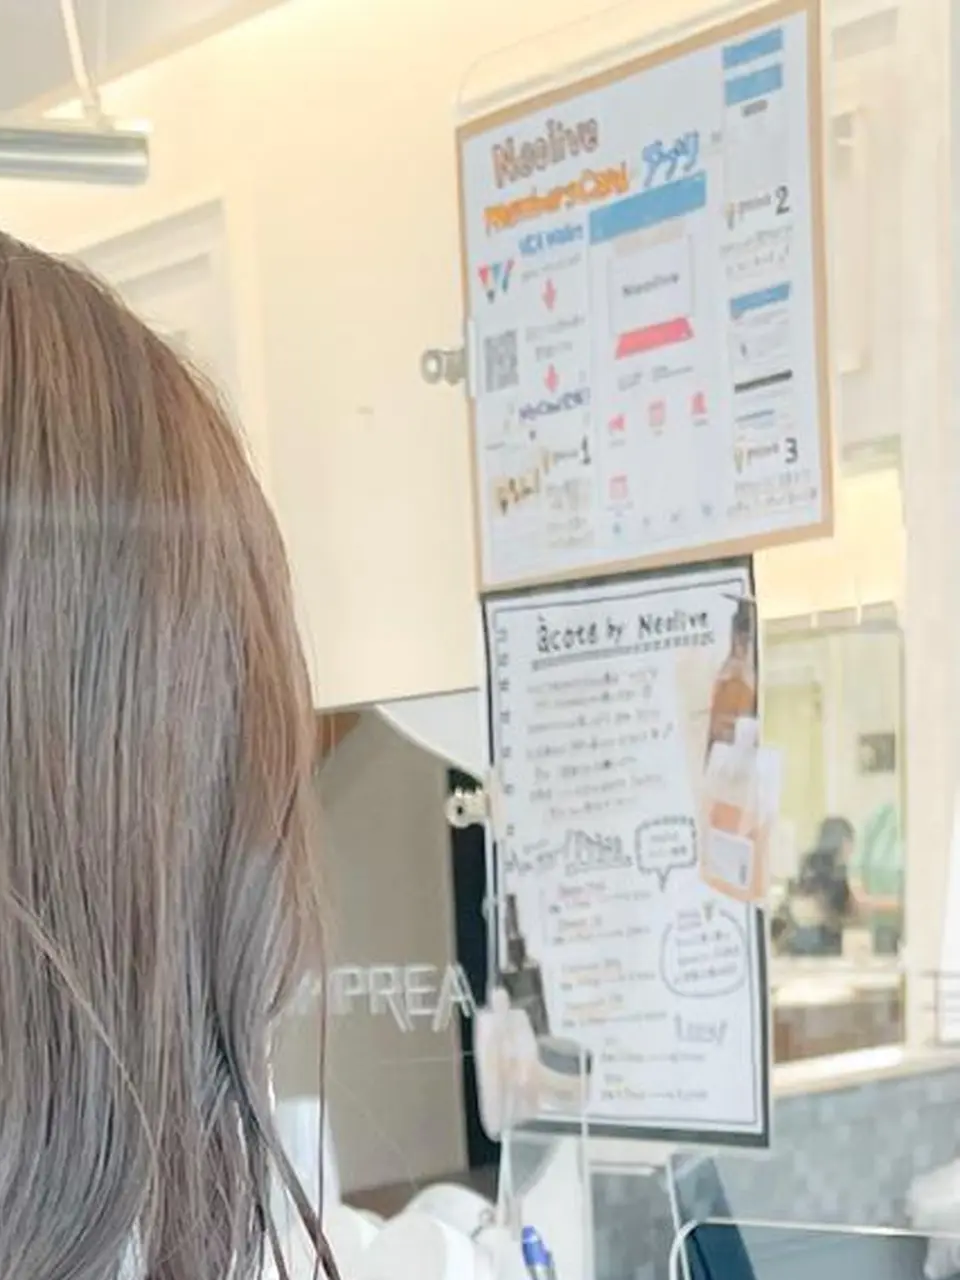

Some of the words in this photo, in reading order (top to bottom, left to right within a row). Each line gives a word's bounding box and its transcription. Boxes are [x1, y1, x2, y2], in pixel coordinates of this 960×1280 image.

[491, 117, 600, 189] Neolive
[774, 184, 791, 216] 2
[784, 436, 799, 465] 3
[606, 615, 624, 647] by
[637, 608, 709, 640] Neolive
